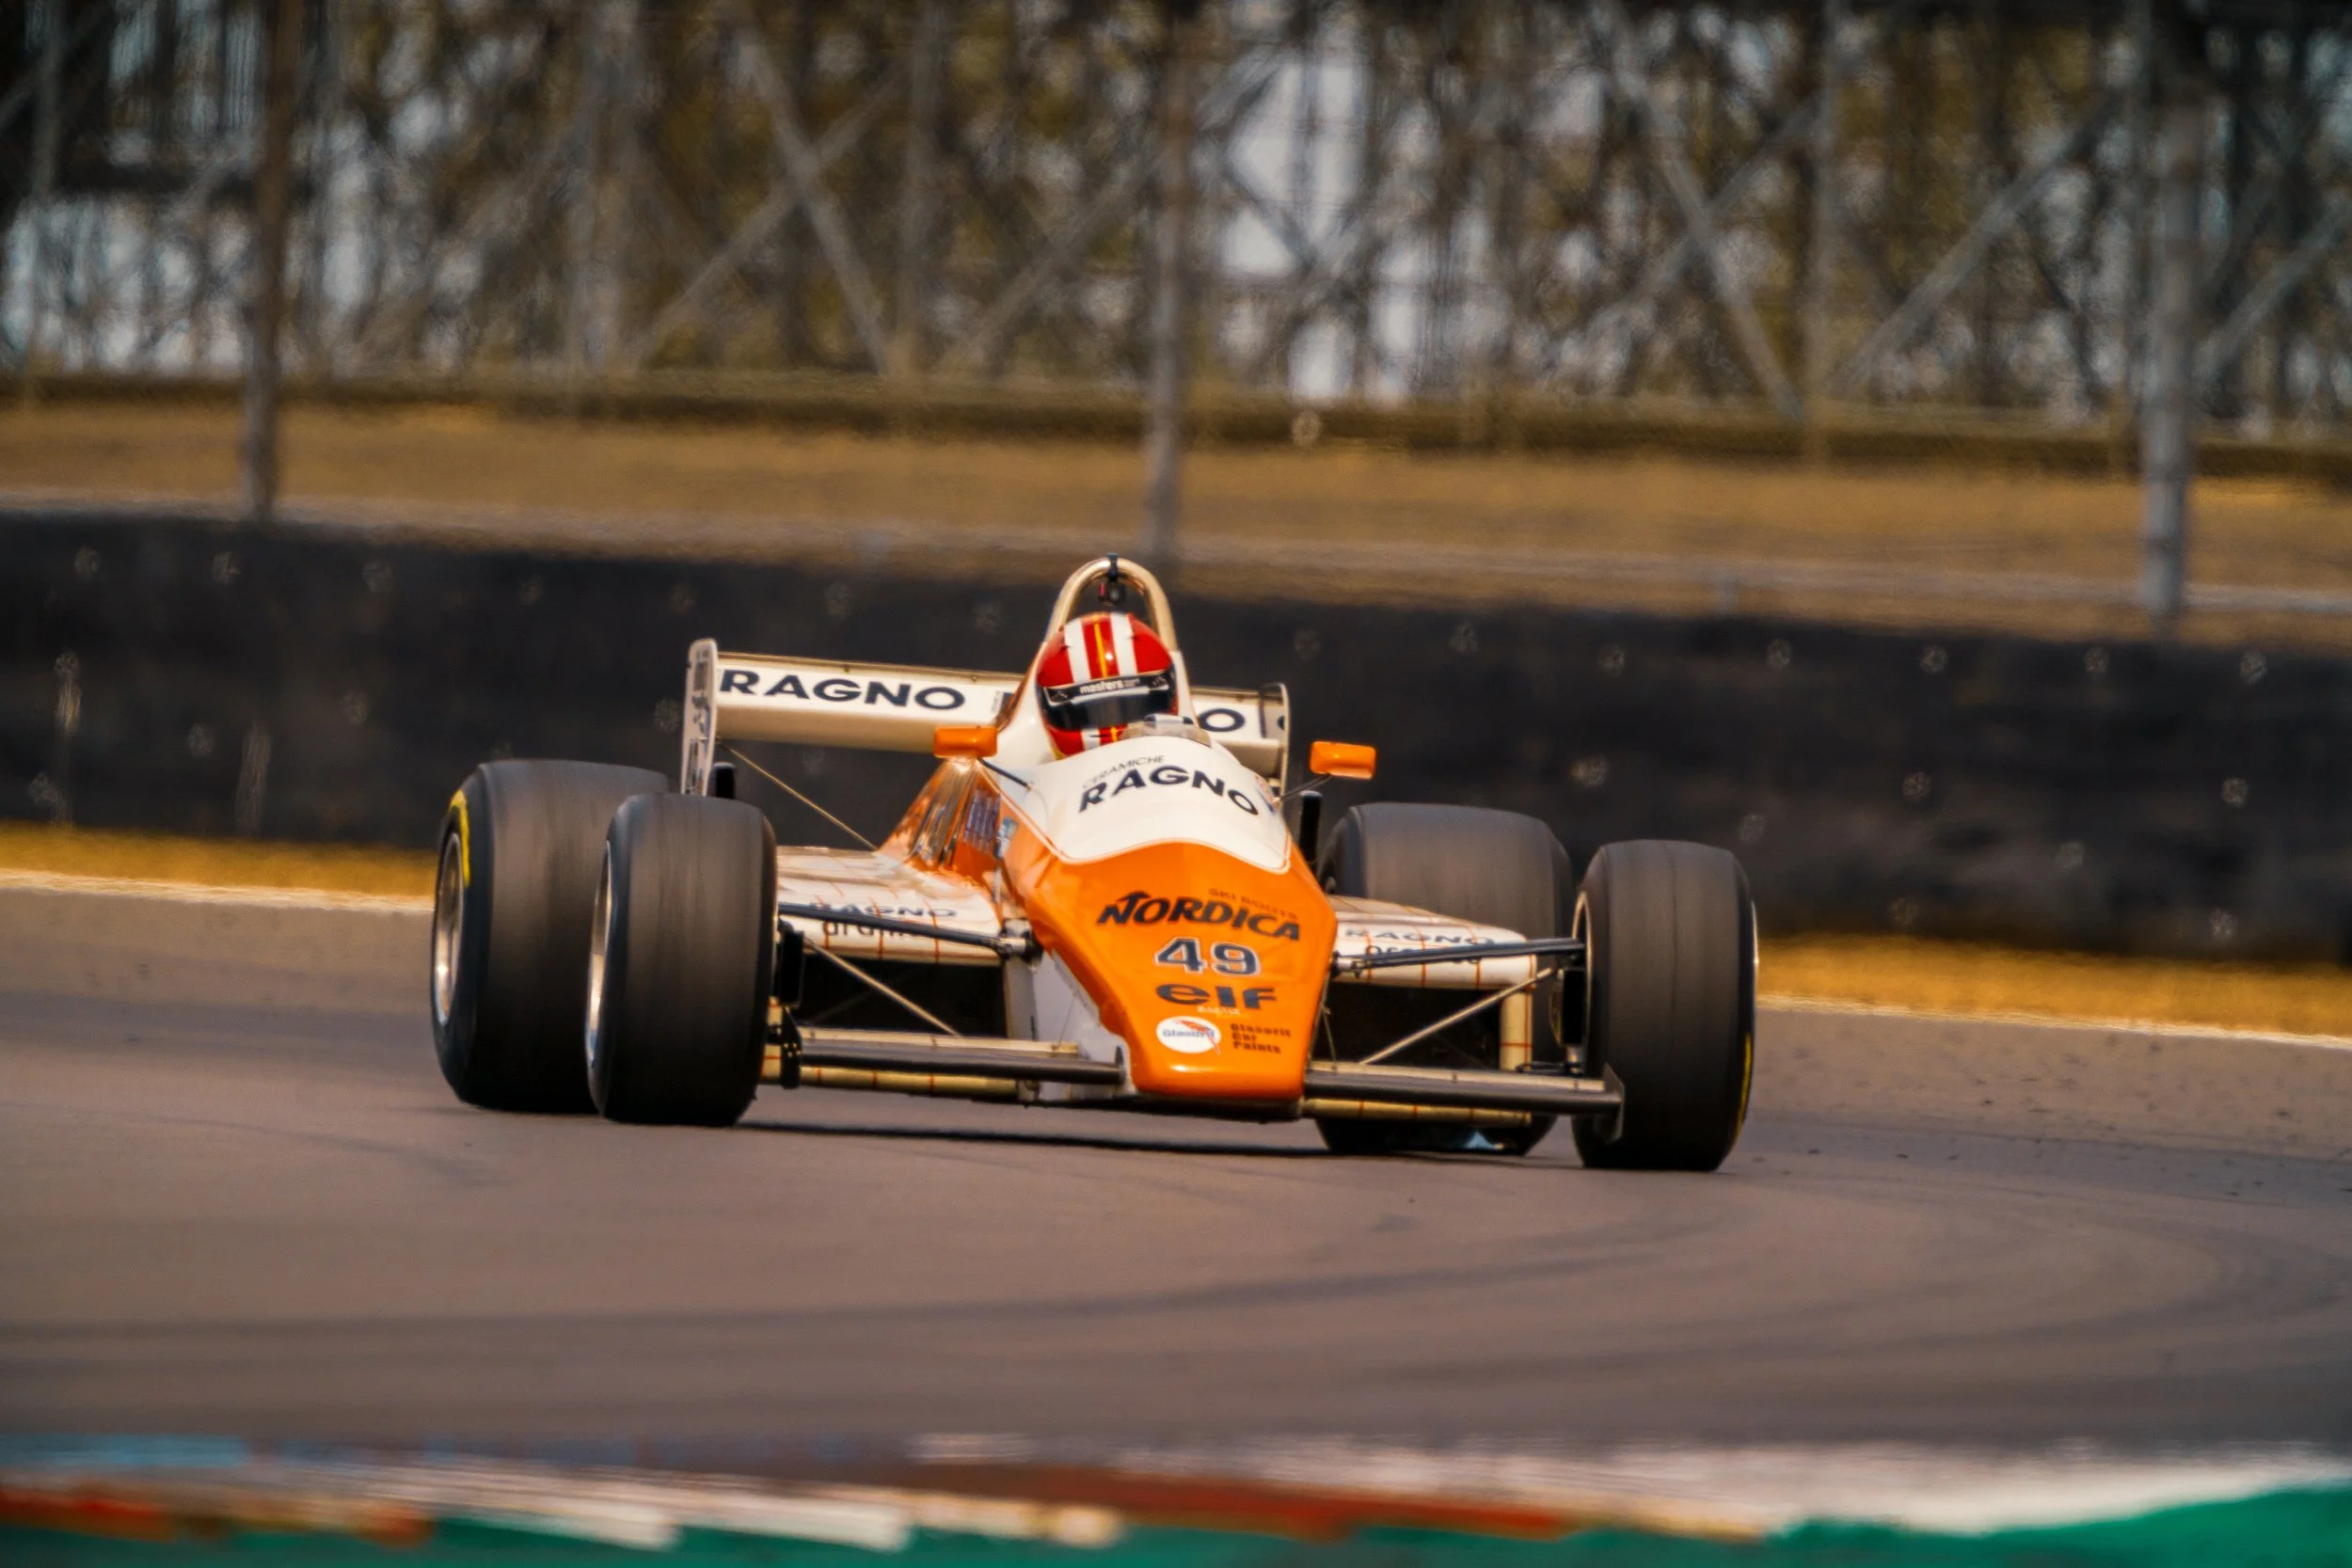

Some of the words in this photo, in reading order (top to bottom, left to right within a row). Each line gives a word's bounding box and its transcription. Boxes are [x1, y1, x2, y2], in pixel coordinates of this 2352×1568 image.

[719, 669, 965, 710] RAGNO
[1078, 765, 1259, 816] RAGNO
[1096, 891, 1300, 942] NORDICA
[1153, 936, 1262, 976] 49
